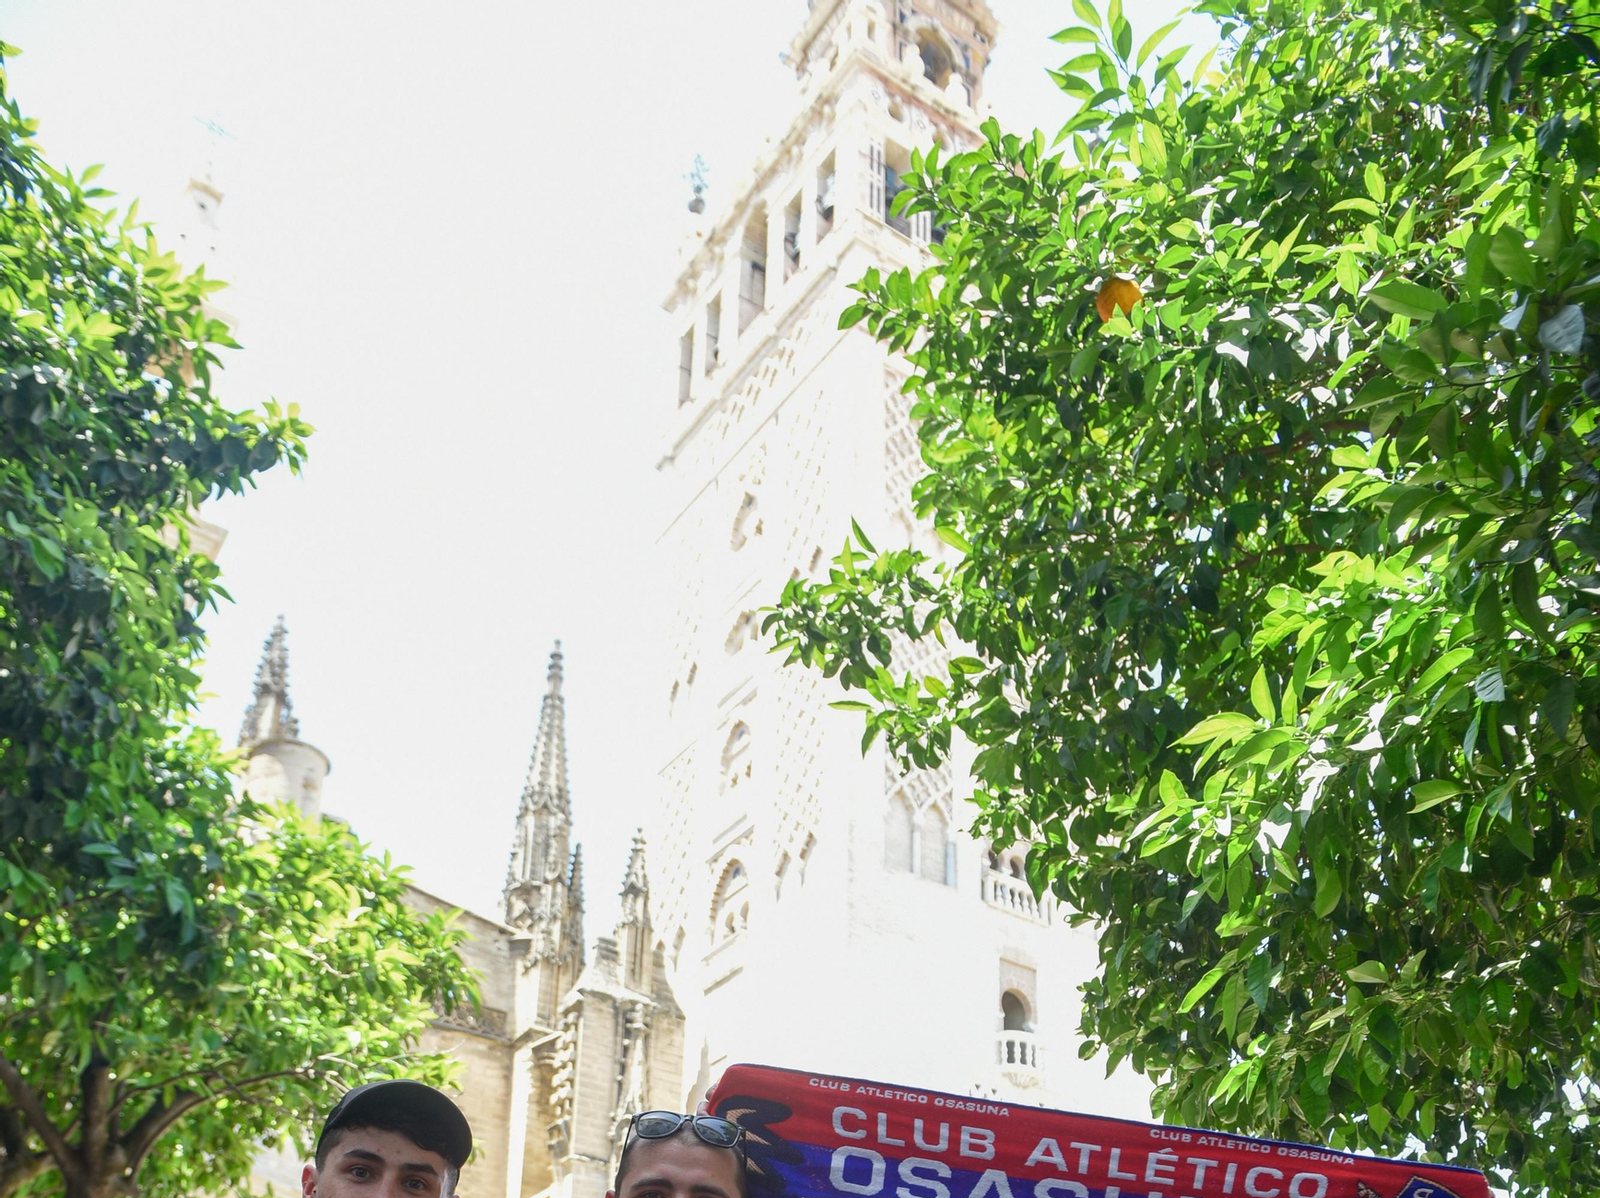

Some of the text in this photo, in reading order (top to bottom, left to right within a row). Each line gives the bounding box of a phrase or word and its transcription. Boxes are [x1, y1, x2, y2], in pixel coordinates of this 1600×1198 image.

[809, 1078, 1010, 1117] CLUB ATLETICO OSASUNA
[831, 1105, 996, 1161] CLUB
[1149, 1128, 1355, 1166] CLUB ATLETICO OSASUNA
